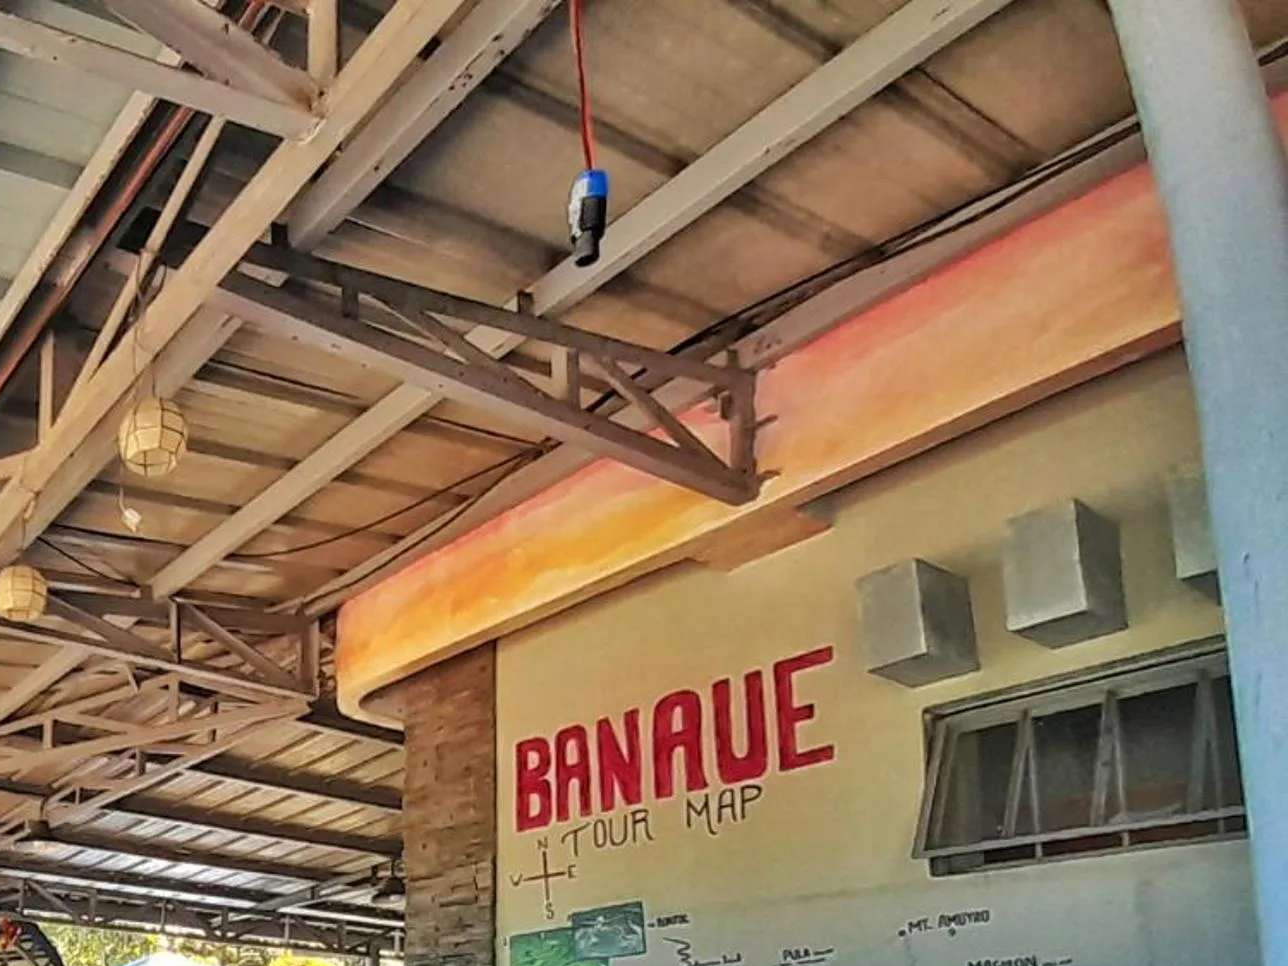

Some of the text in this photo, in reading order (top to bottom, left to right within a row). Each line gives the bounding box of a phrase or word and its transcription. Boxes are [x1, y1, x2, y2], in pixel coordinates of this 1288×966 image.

[515, 646, 836, 833] BANAUE
[561, 784, 763, 857] TOUR MAP
[537, 836, 549, 850] N
[567, 863, 578, 880] E
[545, 902, 555, 920] S
